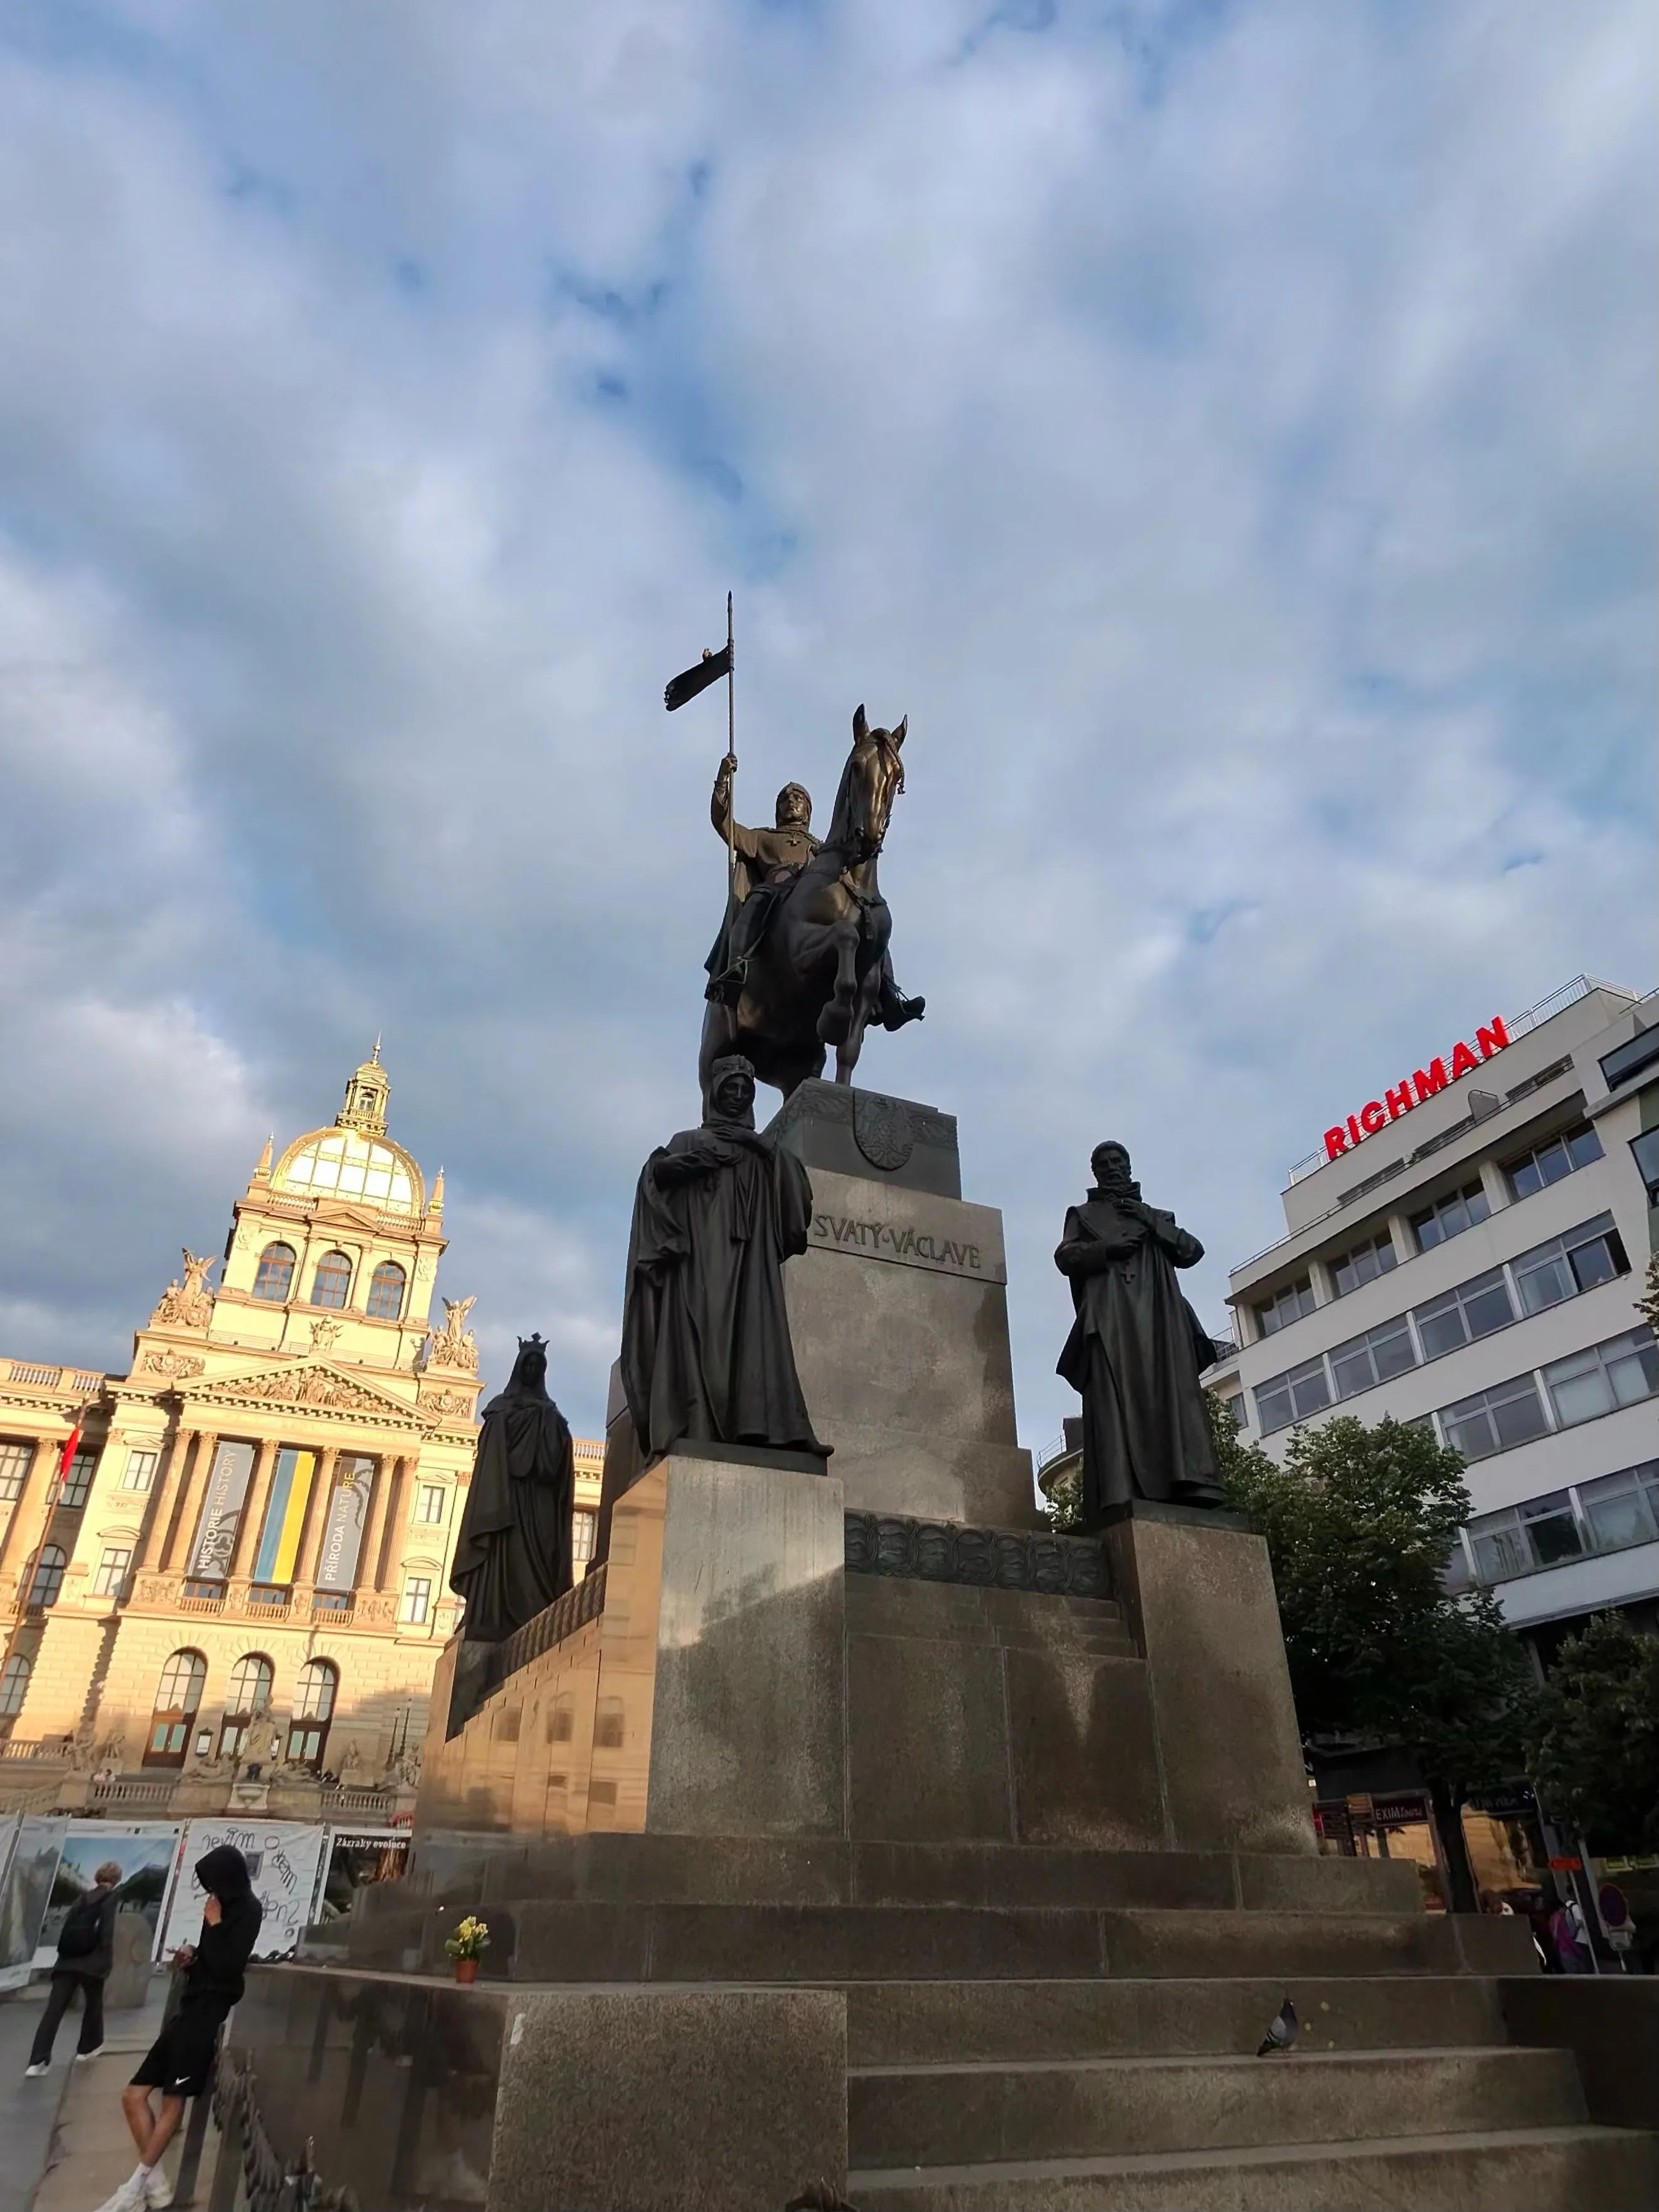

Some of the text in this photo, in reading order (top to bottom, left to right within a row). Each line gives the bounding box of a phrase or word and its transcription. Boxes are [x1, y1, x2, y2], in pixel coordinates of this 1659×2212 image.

[1323, 1014, 1510, 1161] RICHMAN
[197, 1449, 237, 1570] HISTORIE HISTORY
[324, 1472, 356, 1582] PŘÍRODA NATURE
[336, 1838, 406, 1851] Zázraky evoluce
